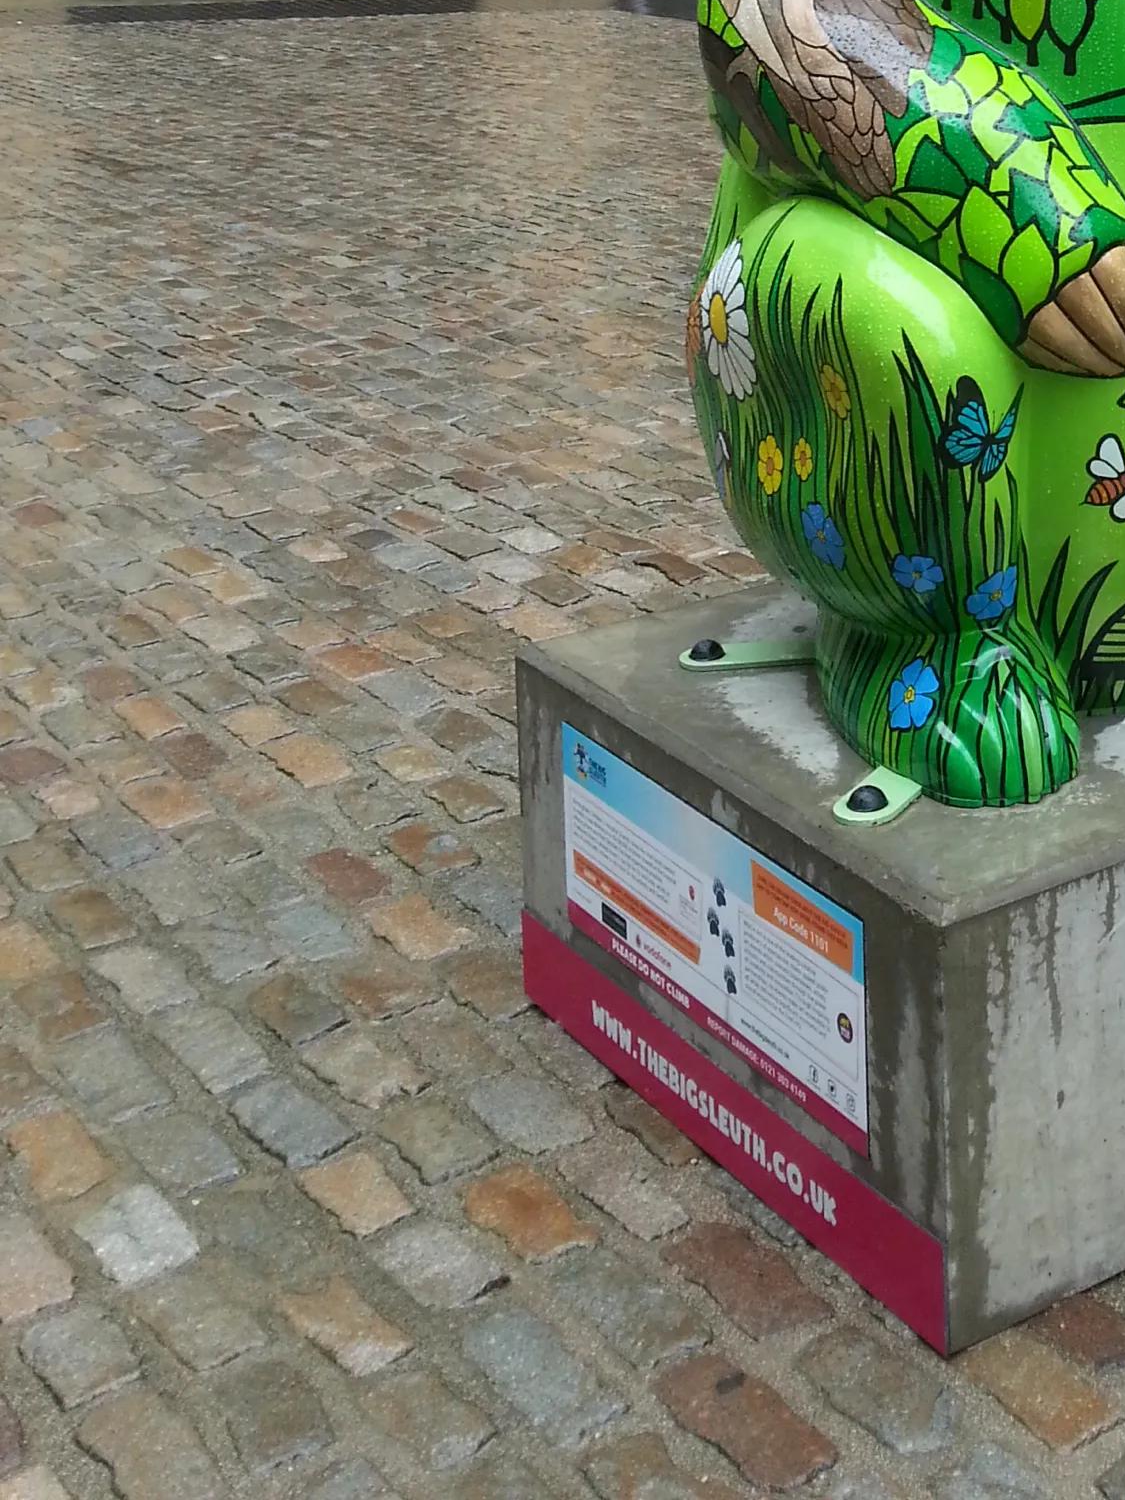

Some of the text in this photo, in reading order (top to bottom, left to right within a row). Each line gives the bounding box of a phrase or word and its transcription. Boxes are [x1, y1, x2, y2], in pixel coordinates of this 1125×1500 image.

[773, 907, 829, 953] App Code 1101
[612, 938, 691, 1010] PLEASE DO NOT CLIMB
[706, 1016, 730, 1041] REPORT
[731, 1035, 759, 1065] DAMAGE:
[760, 1058, 776, 1078] 0121
[790, 1082, 807, 1102] 4149
[591, 999, 838, 1227] WWW.THEBIGSLEUTH.CO.UK
